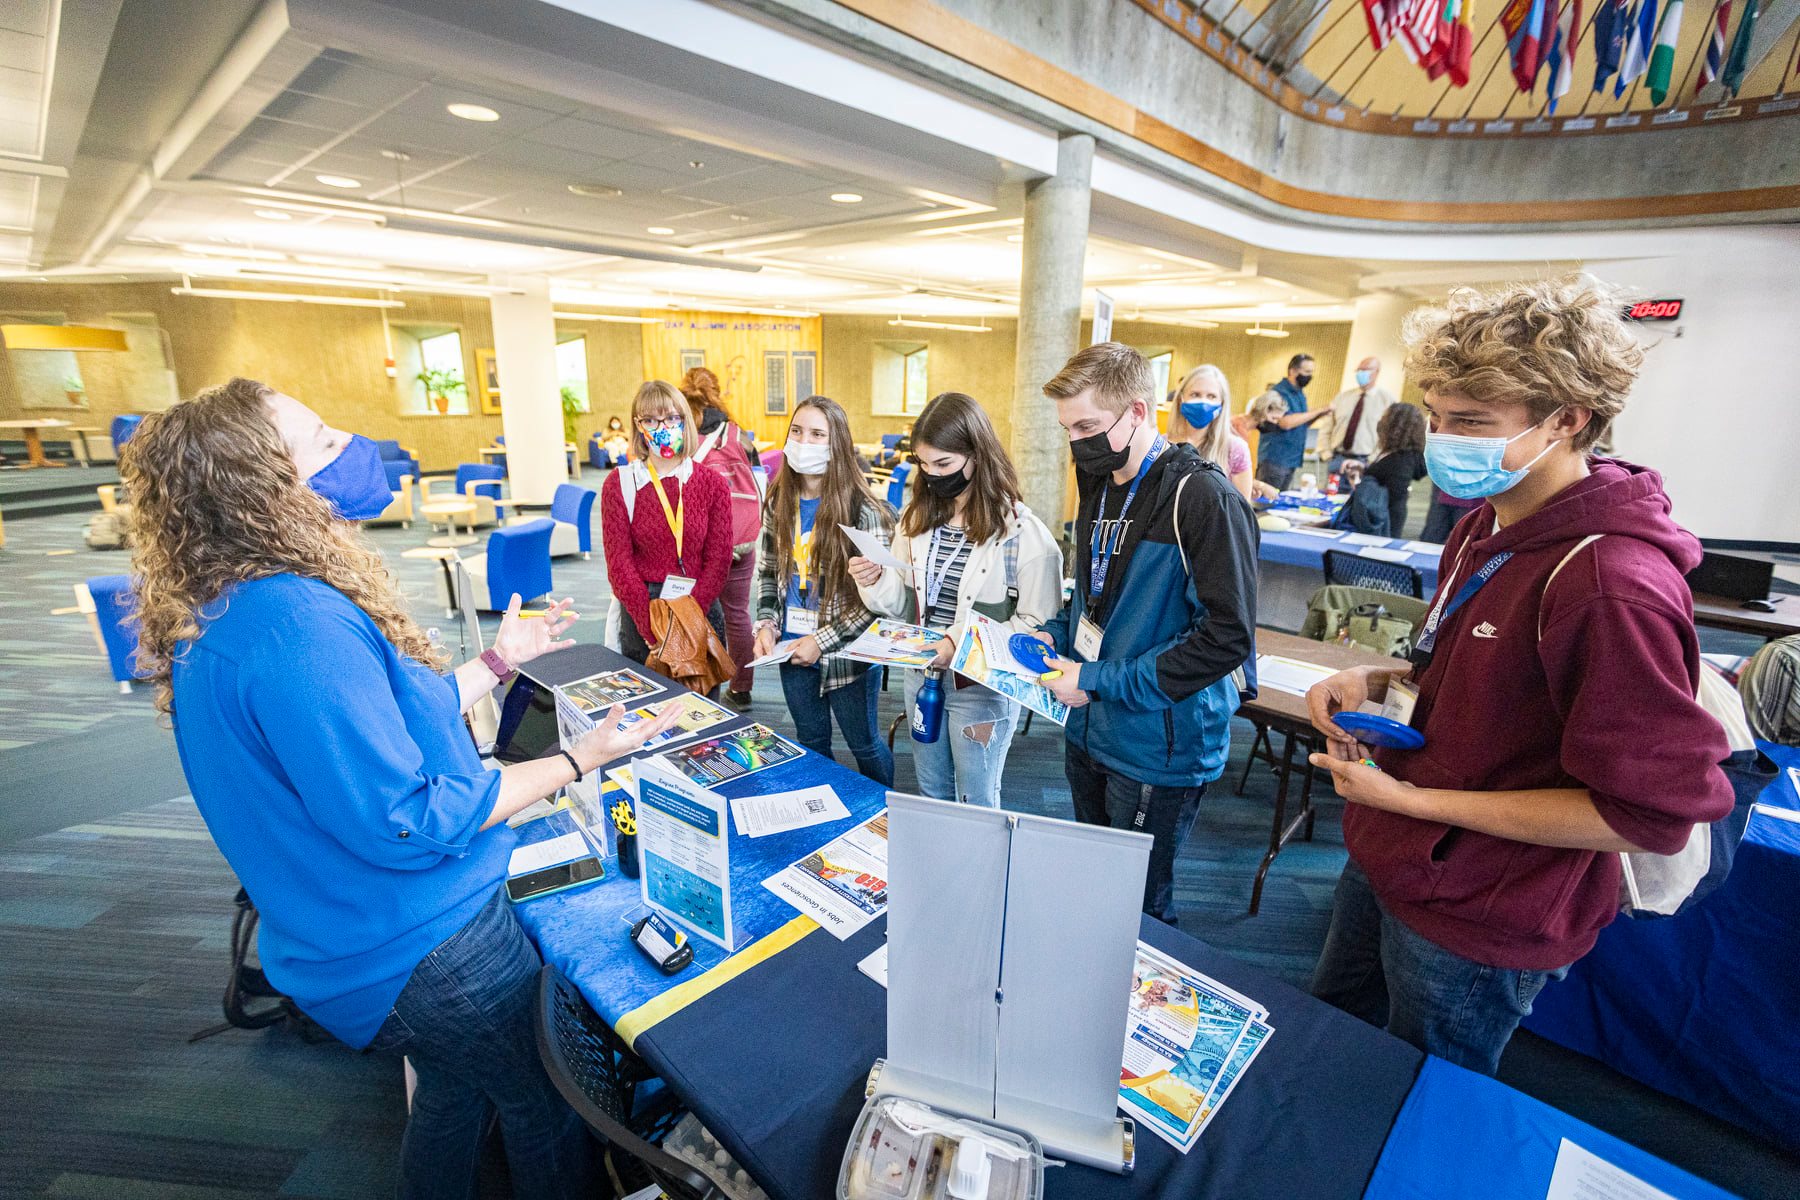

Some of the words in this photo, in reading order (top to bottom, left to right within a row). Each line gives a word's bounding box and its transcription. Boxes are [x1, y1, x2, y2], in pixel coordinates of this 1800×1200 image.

[690, 322, 727, 330] ALUMNI
[733, 323, 801, 331] ASSOCIATION
[1478, 621, 1497, 635] NIKE
[855, 873, 888, 891] GEO
[780, 881, 819, 909] Geosciences
[819, 906, 828, 914] in
[828, 911, 844, 925] Jobs
[1147, 1029, 1165, 1042] Biology
[1141, 1037, 1159, 1050] Biology
